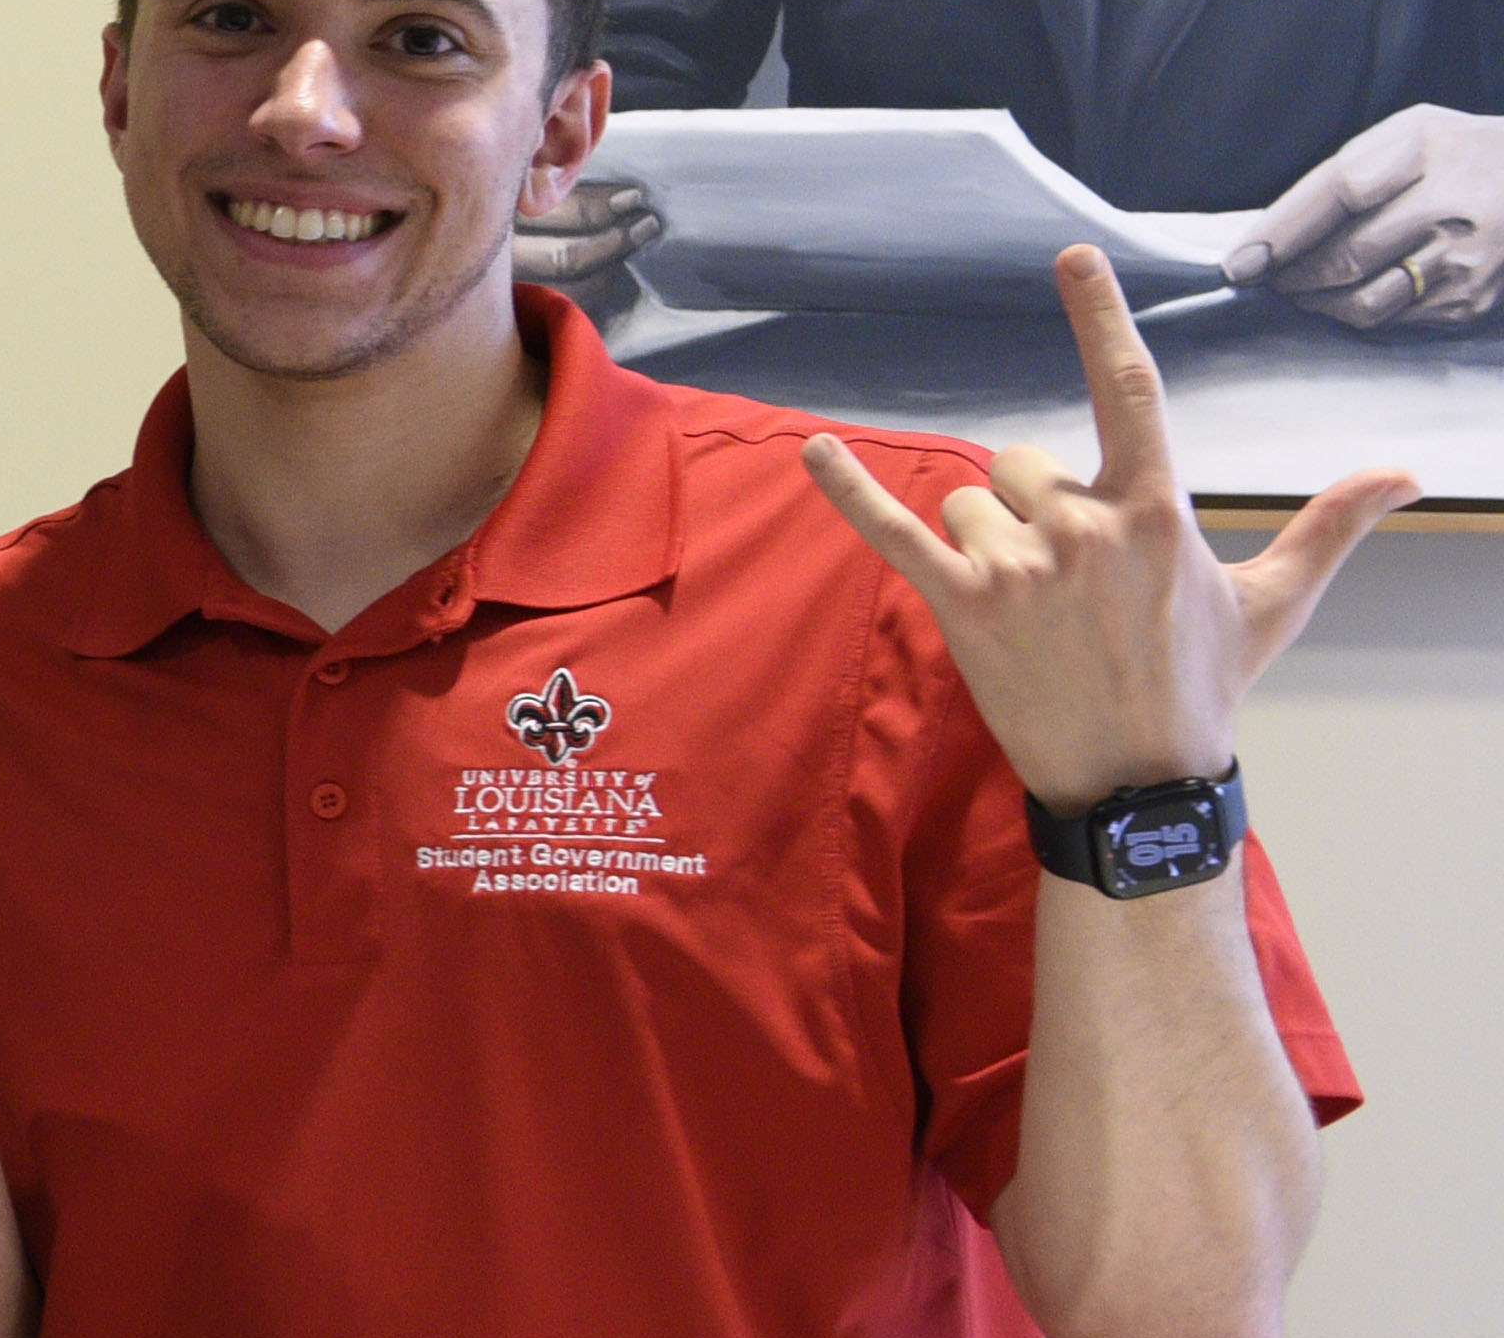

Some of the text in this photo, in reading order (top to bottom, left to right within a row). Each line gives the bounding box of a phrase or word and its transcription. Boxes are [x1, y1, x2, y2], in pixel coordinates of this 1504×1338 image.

[461, 769, 657, 790] UNIVERSITY of
[453, 786, 664, 818] LOUISIANA
[467, 815, 640, 834] LAFAYETTE
[416, 842, 707, 875] Student Government
[472, 869, 639, 895] Association
